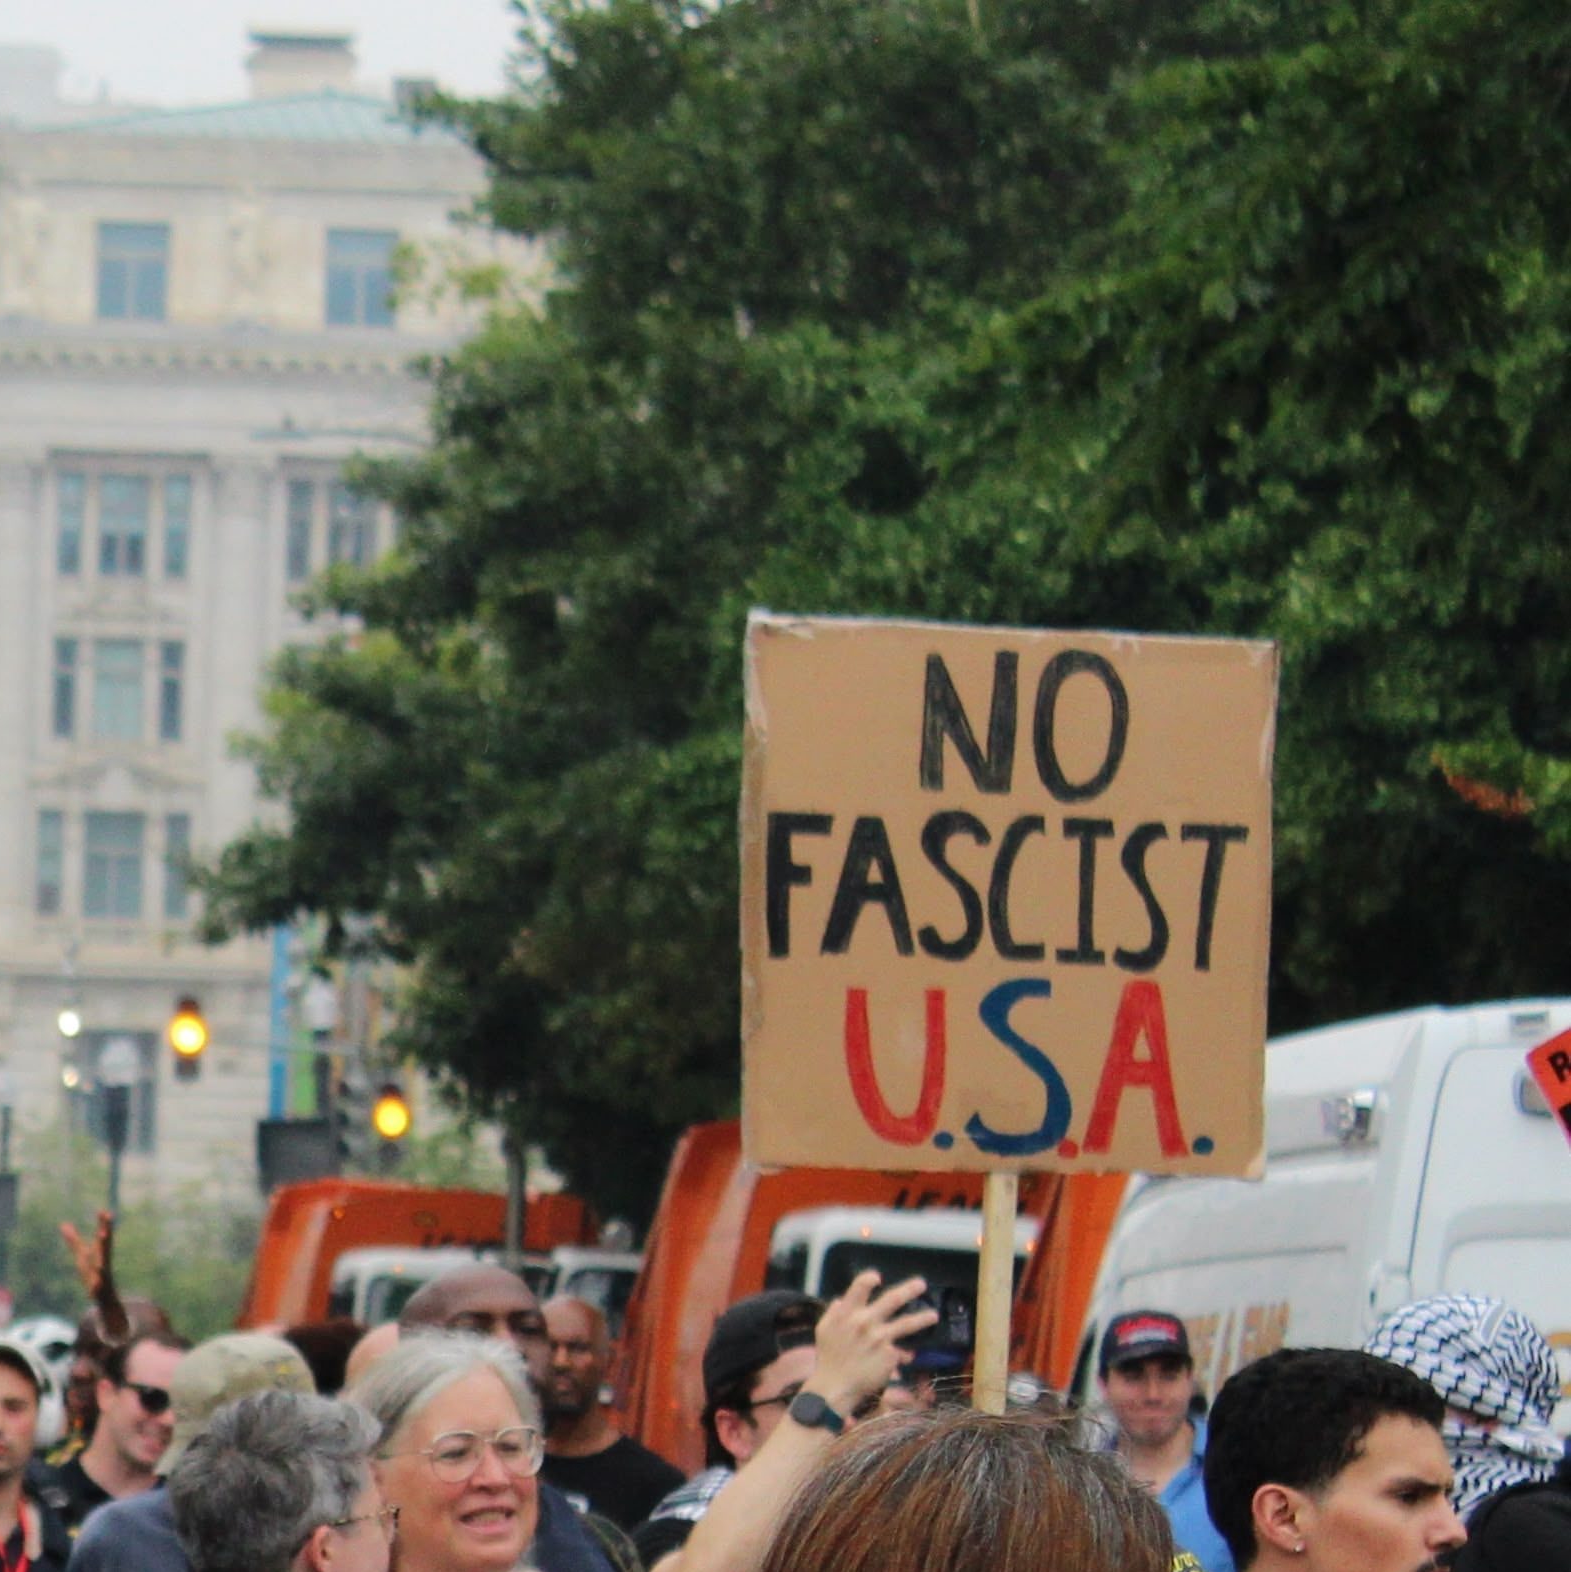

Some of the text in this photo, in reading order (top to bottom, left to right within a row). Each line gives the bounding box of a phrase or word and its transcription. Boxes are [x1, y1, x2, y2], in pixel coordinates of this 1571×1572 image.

[920, 650, 1129, 803] NO
[766, 810, 1249, 973] FASCIST
[844, 979, 1214, 1159] U.S.A.
